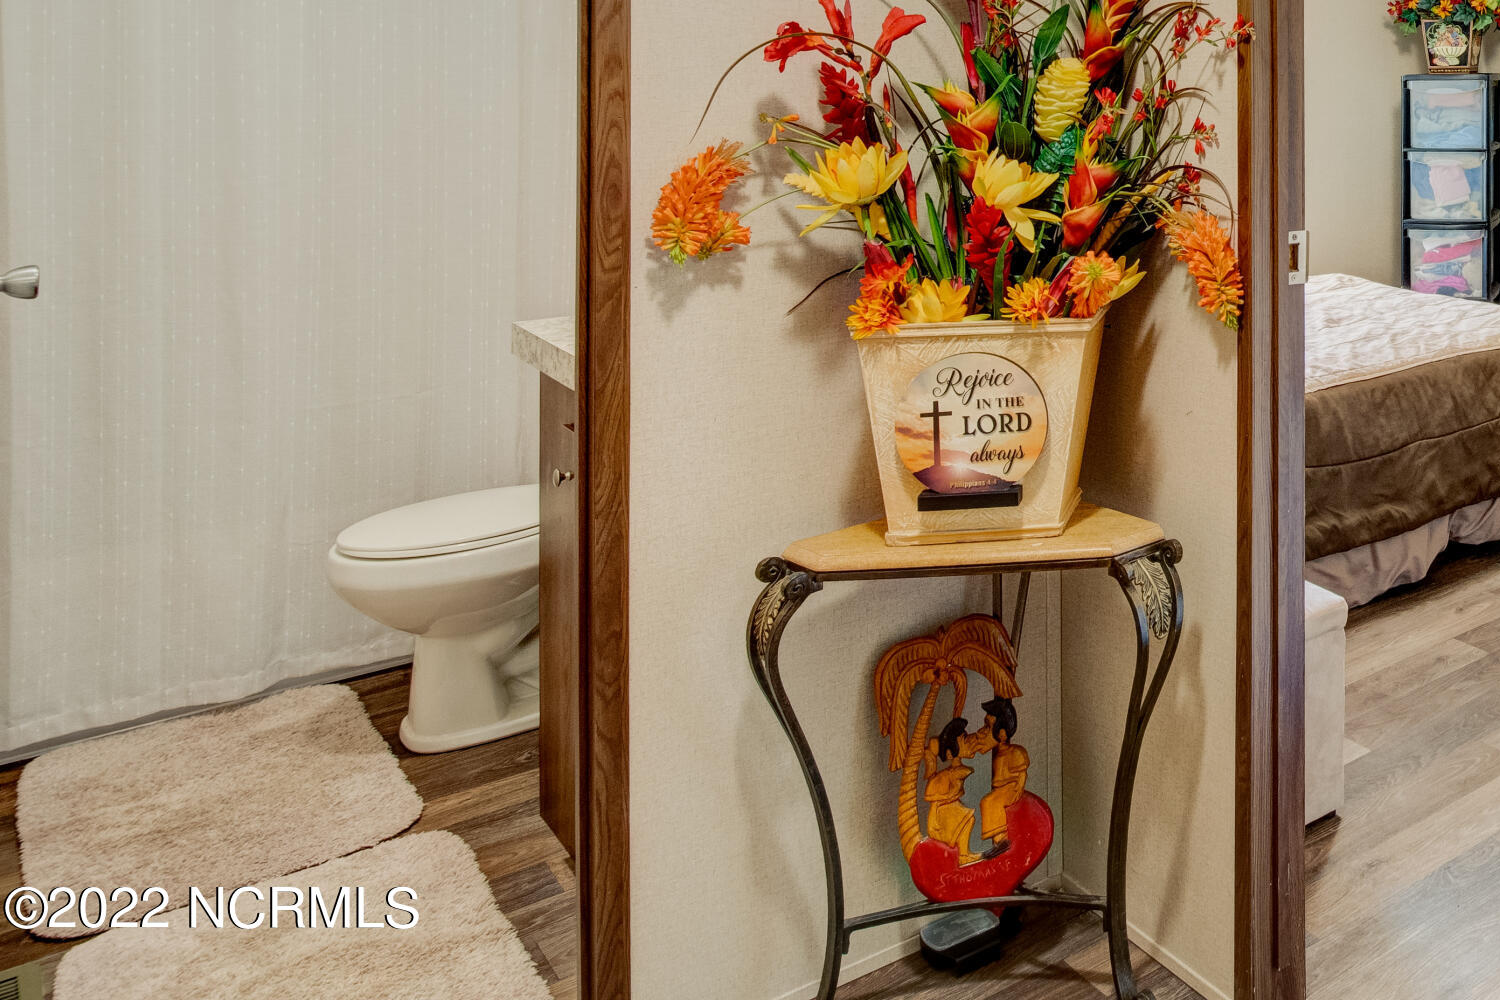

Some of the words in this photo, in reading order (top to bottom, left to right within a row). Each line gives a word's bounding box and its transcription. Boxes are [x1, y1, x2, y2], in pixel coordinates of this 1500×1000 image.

[932, 366, 1014, 405] Rejoice
[976, 398, 993, 410] IN
[995, 396, 1025, 408] THE
[962, 412, 1032, 436] LORD
[970, 440, 1025, 475] always
